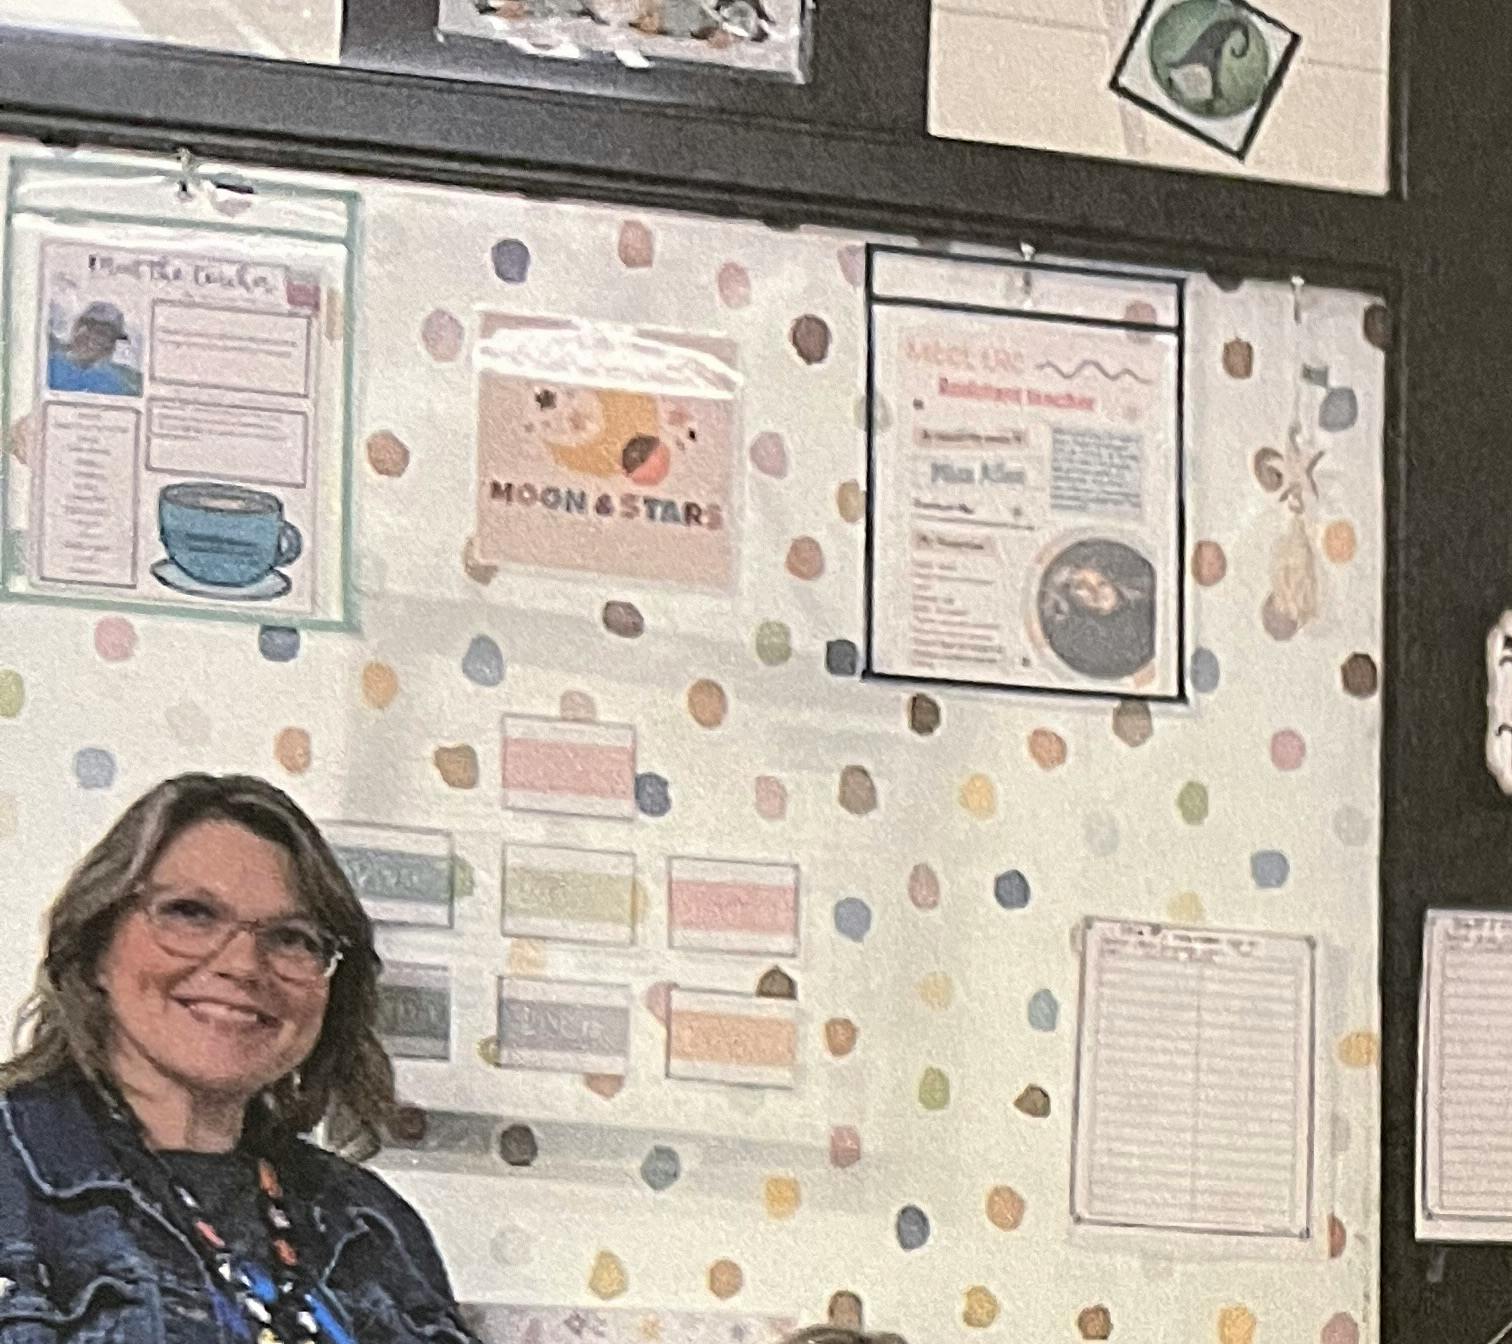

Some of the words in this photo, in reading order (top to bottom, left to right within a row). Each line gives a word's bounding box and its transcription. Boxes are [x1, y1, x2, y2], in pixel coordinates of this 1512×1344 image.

[489, 479, 587, 515] MOON
[596, 493, 613, 517] &
[619, 492, 723, 531] STARS
